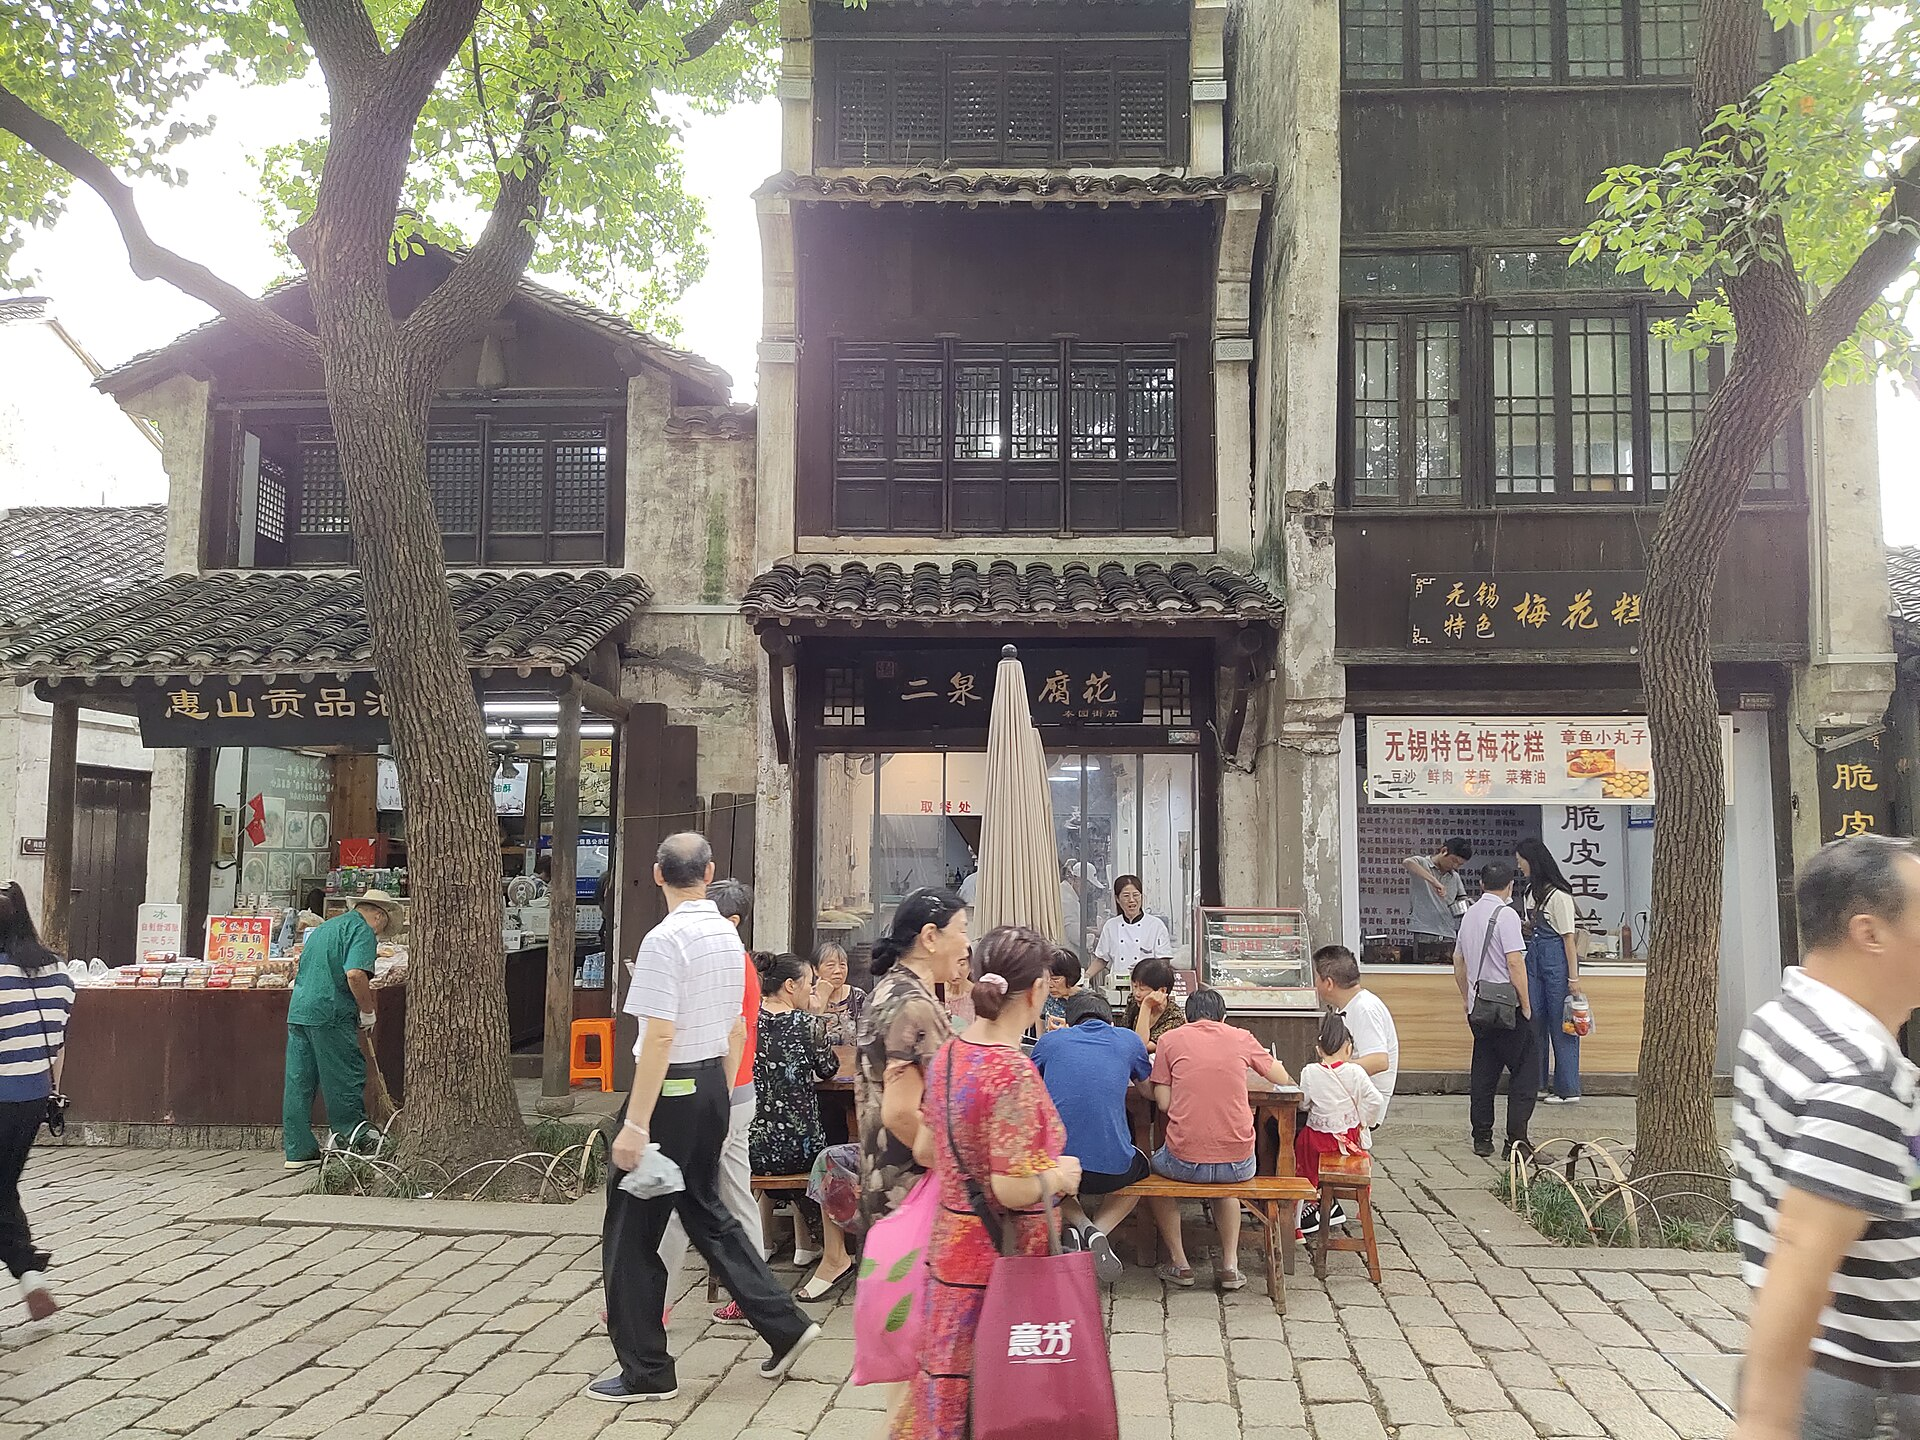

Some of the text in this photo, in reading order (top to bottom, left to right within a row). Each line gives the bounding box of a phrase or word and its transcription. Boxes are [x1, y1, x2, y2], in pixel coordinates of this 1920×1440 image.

[1444, 581, 1500, 609] 无锡
[1512, 588, 1642, 631] 梅花糕
[1443, 612, 1496, 640] 特色
[1385, 728, 1545, 763] 无锡特色梅花糕
[1560, 729, 1647, 746] 章鱼小丸子
[1391, 769, 1547, 785] 豆沙 鲜肉 芝麻 菜猪油
[920, 800, 971, 813] 取餐处
[1832, 763, 1879, 838] 脆皮
[219, 920, 263, 933] 中秋月饼
[216, 933, 264, 944] 厂家直销
